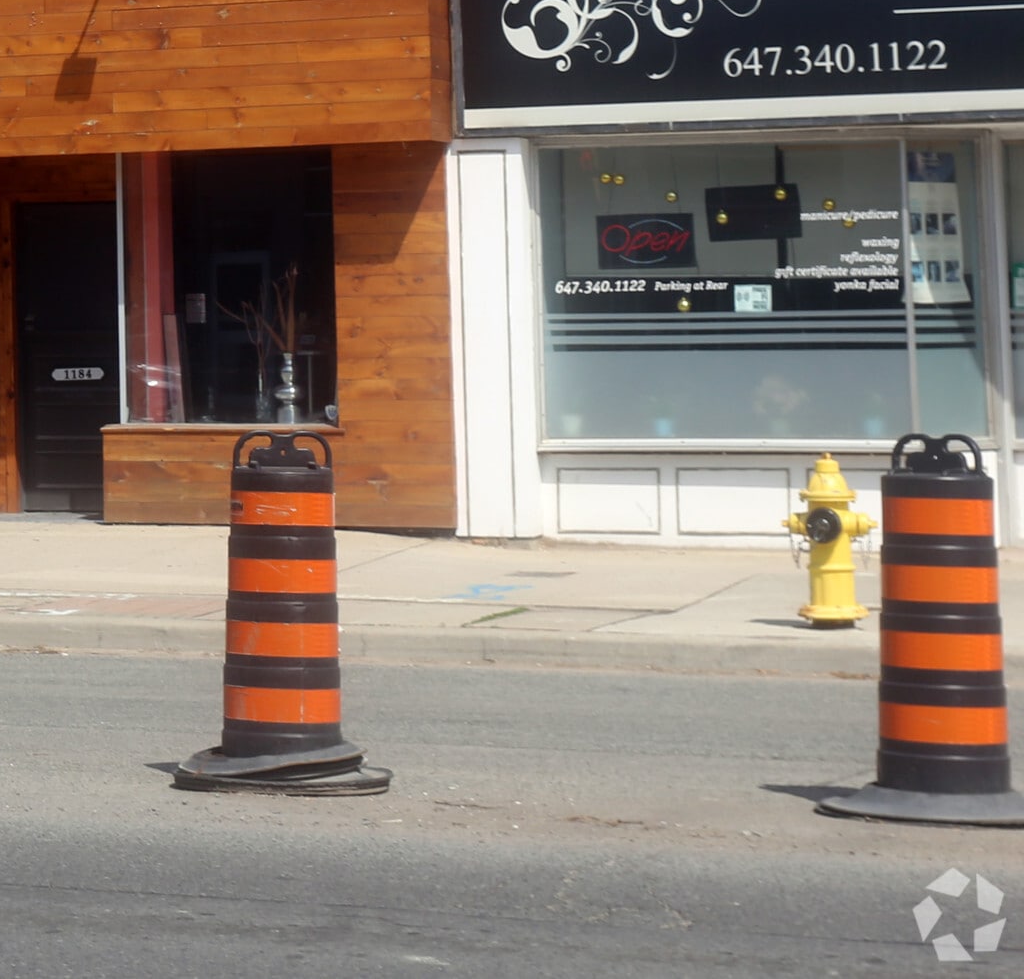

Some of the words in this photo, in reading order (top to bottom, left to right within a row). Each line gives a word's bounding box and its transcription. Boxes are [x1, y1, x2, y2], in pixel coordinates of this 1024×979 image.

[723, 39, 948, 78] 647.340.1122
[800, 209, 899, 222] manicure/pedicure
[601, 224, 690, 256] Open
[861, 236, 899, 249] waxing
[840, 251, 898, 264] reflexology
[775, 266, 794, 279] gift
[796, 265, 849, 278] certificate
[850, 265, 898, 276] available
[555, 280, 646, 295] 647.340.1122
[654, 281, 692, 293] Parking
[693, 281, 705, 291] at
[705, 280, 728, 291] Rear
[868, 279, 899, 292] facial
[64, 368, 92, 380] 1184
